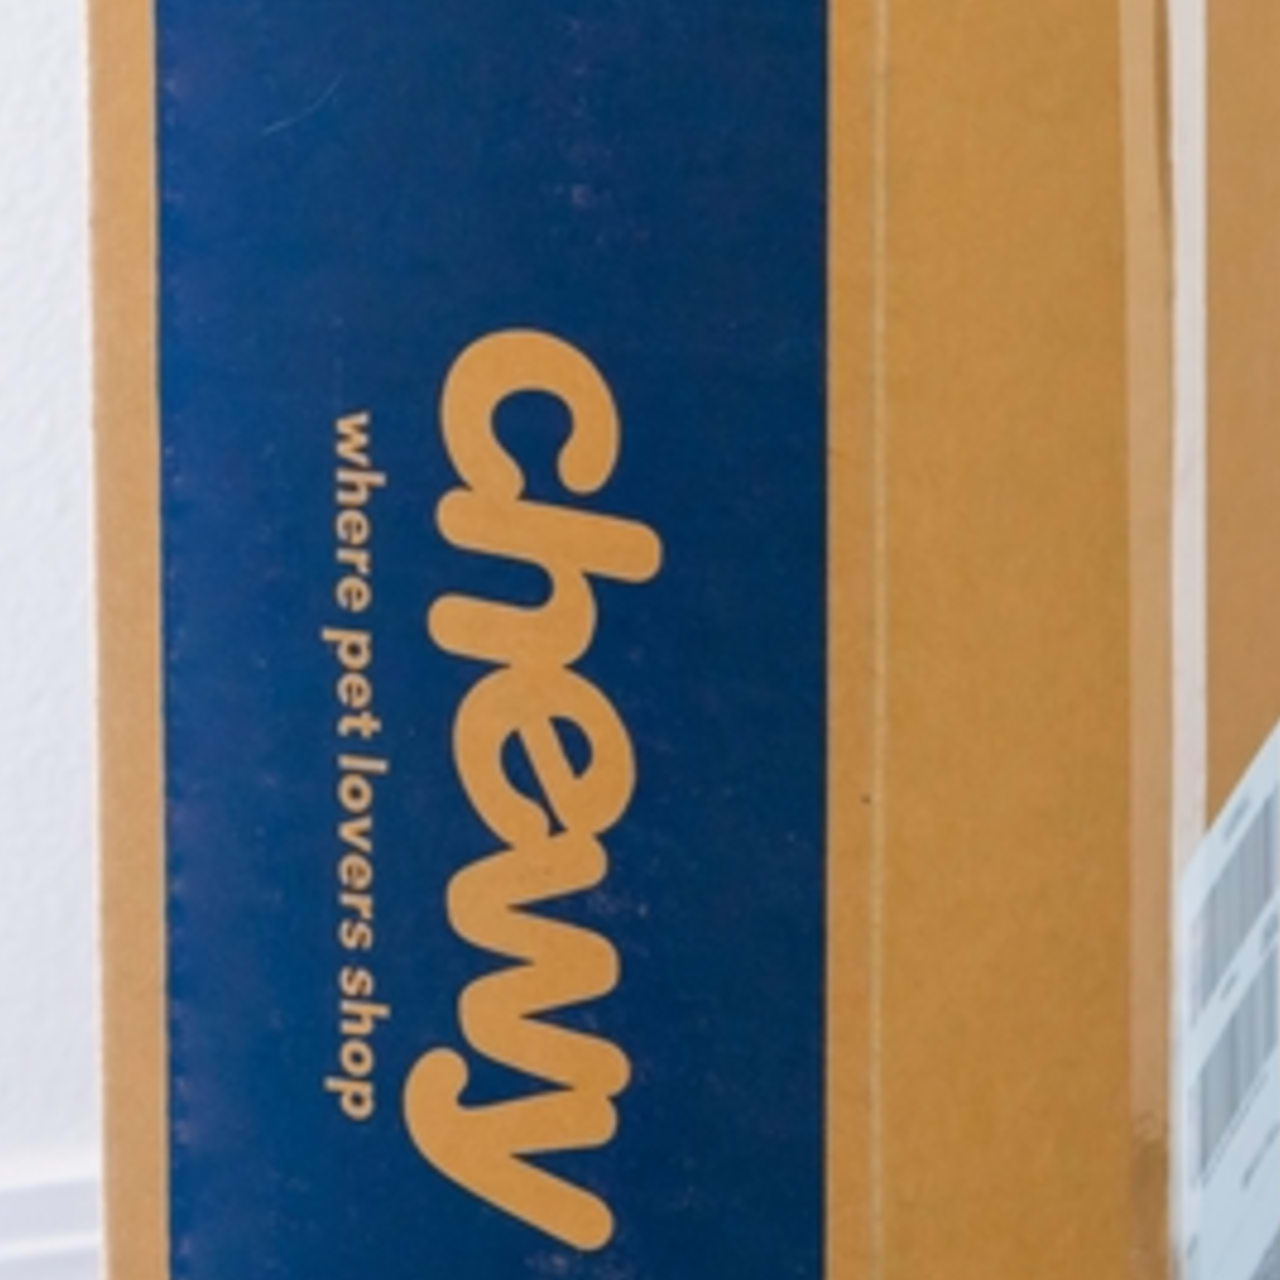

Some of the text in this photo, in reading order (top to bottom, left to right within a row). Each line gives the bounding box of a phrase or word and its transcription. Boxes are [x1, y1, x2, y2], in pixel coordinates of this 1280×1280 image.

[321, 412, 391, 1121] where pet lovers shop
[404, 328, 663, 1252] chewy
